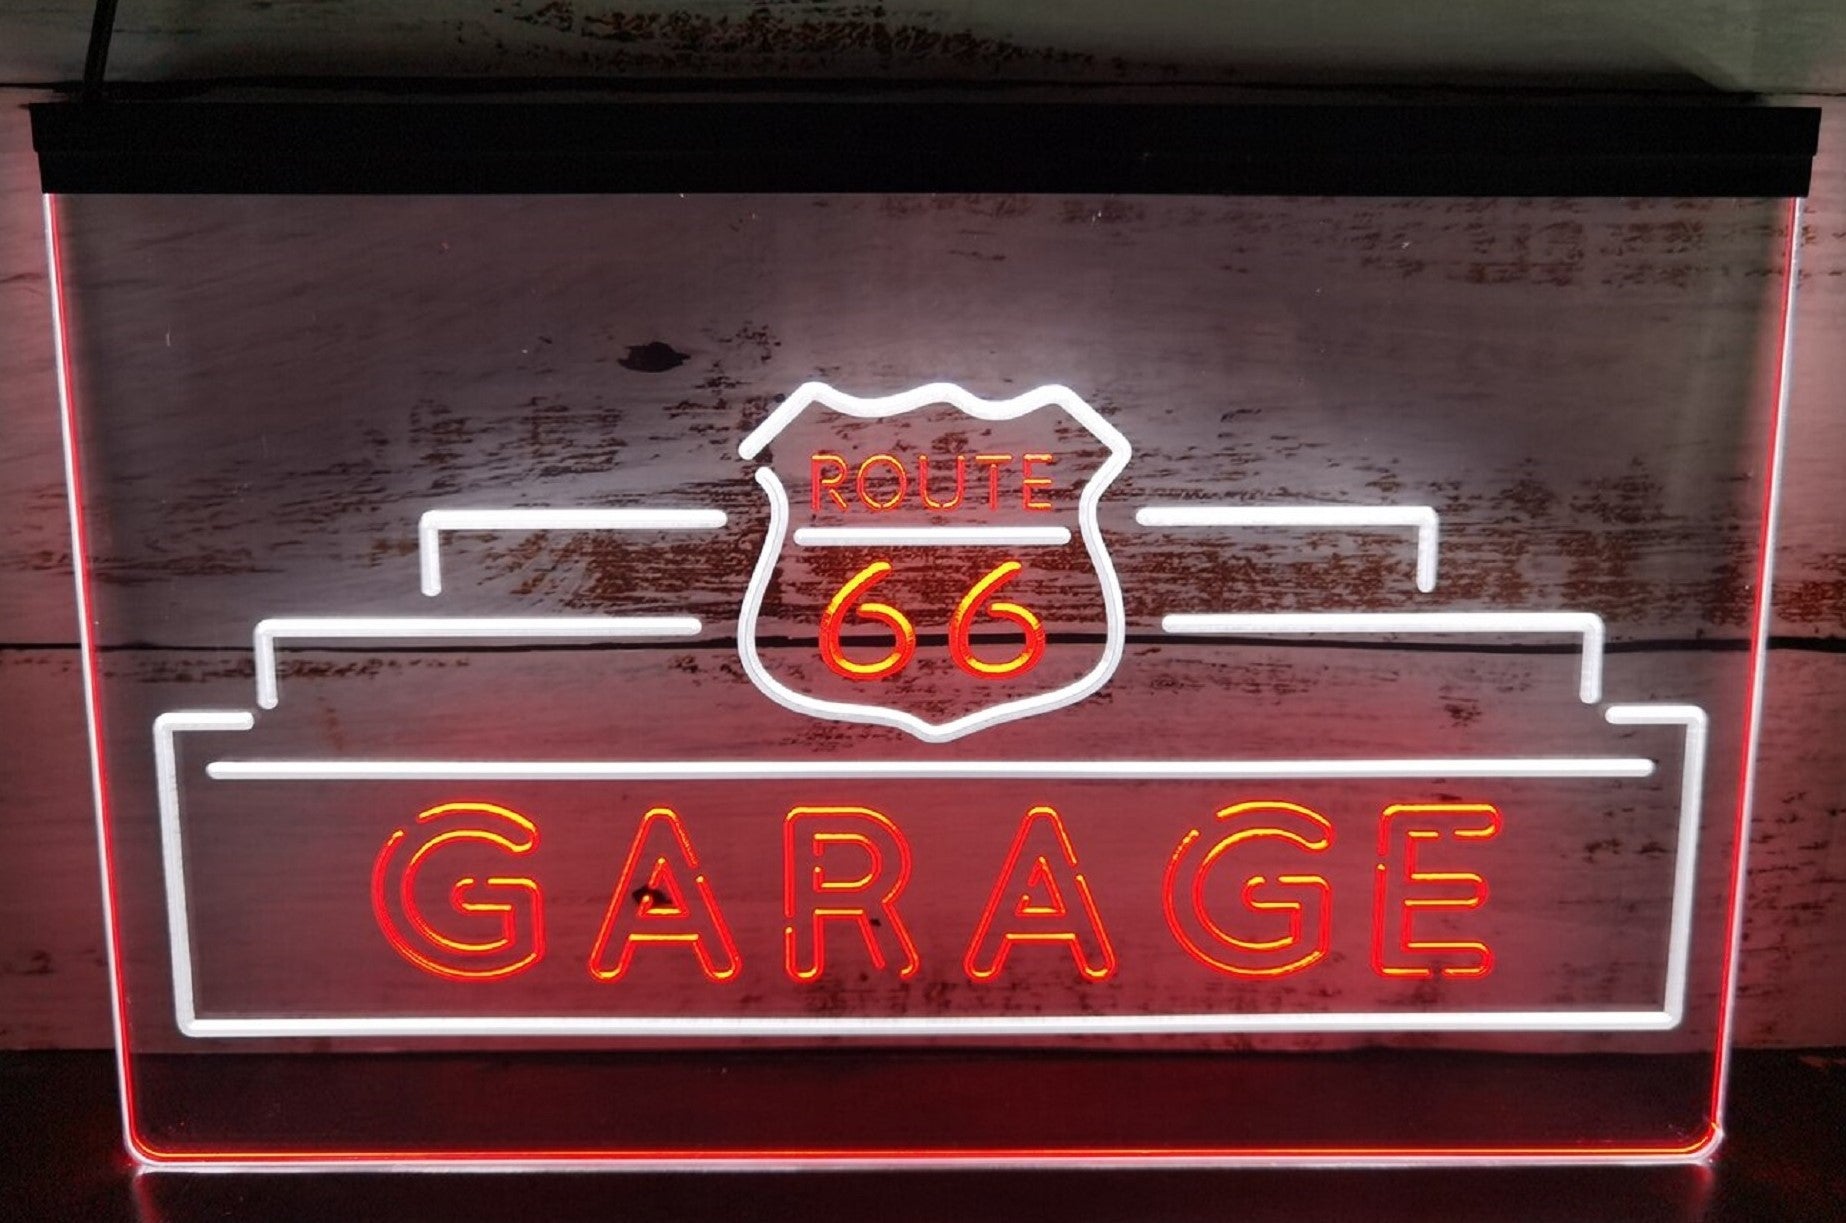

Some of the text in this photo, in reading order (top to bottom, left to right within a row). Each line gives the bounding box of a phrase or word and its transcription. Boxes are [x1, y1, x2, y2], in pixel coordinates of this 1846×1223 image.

[810, 453, 1054, 512] ROUTE
[817, 560, 1047, 682] 66
[371, 800, 1503, 982] GARAGE
